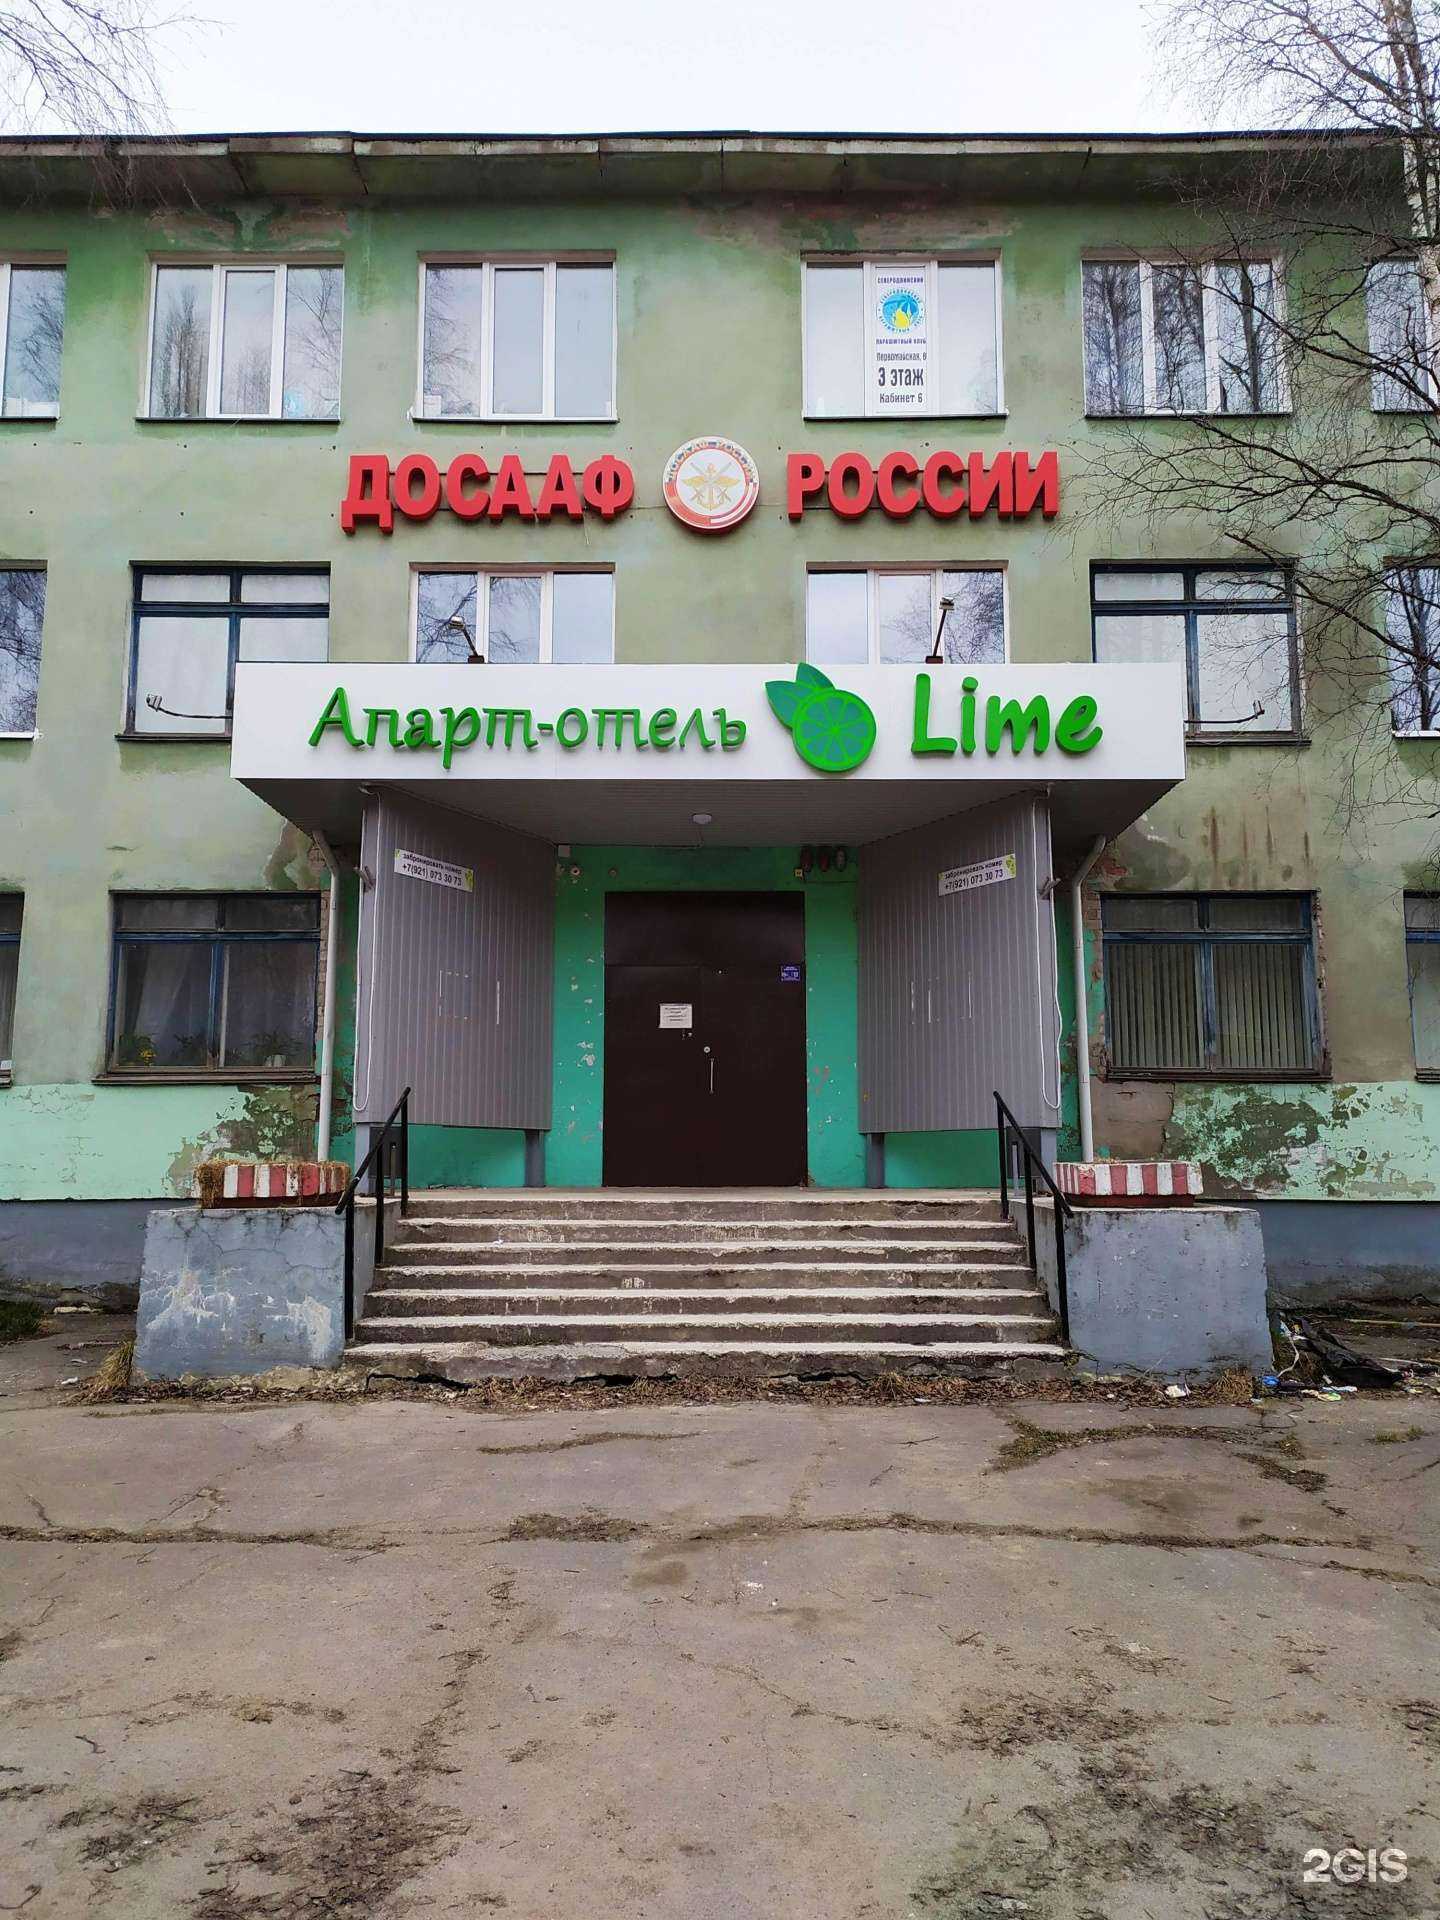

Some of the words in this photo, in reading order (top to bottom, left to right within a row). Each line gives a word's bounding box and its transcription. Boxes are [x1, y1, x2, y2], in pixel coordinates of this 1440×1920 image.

[878, 366, 886, 387] 3
[890, 368, 924, 387] этаж
[879, 393, 915, 403] Кабинет
[341, 453, 635, 535] ДОСААФ
[787, 451, 1060, 521] РОССИИ
[308, 687, 747, 770] Апарт-отель
[911, 673, 1104, 757] Lime
[403, 863, 428, 879] +7(921)
[945, 877, 969, 891] +7(921)
[971, 874, 983, 885] 073
[985, 871, 993, 881] 30
[995, 868, 1004, 878] 73
